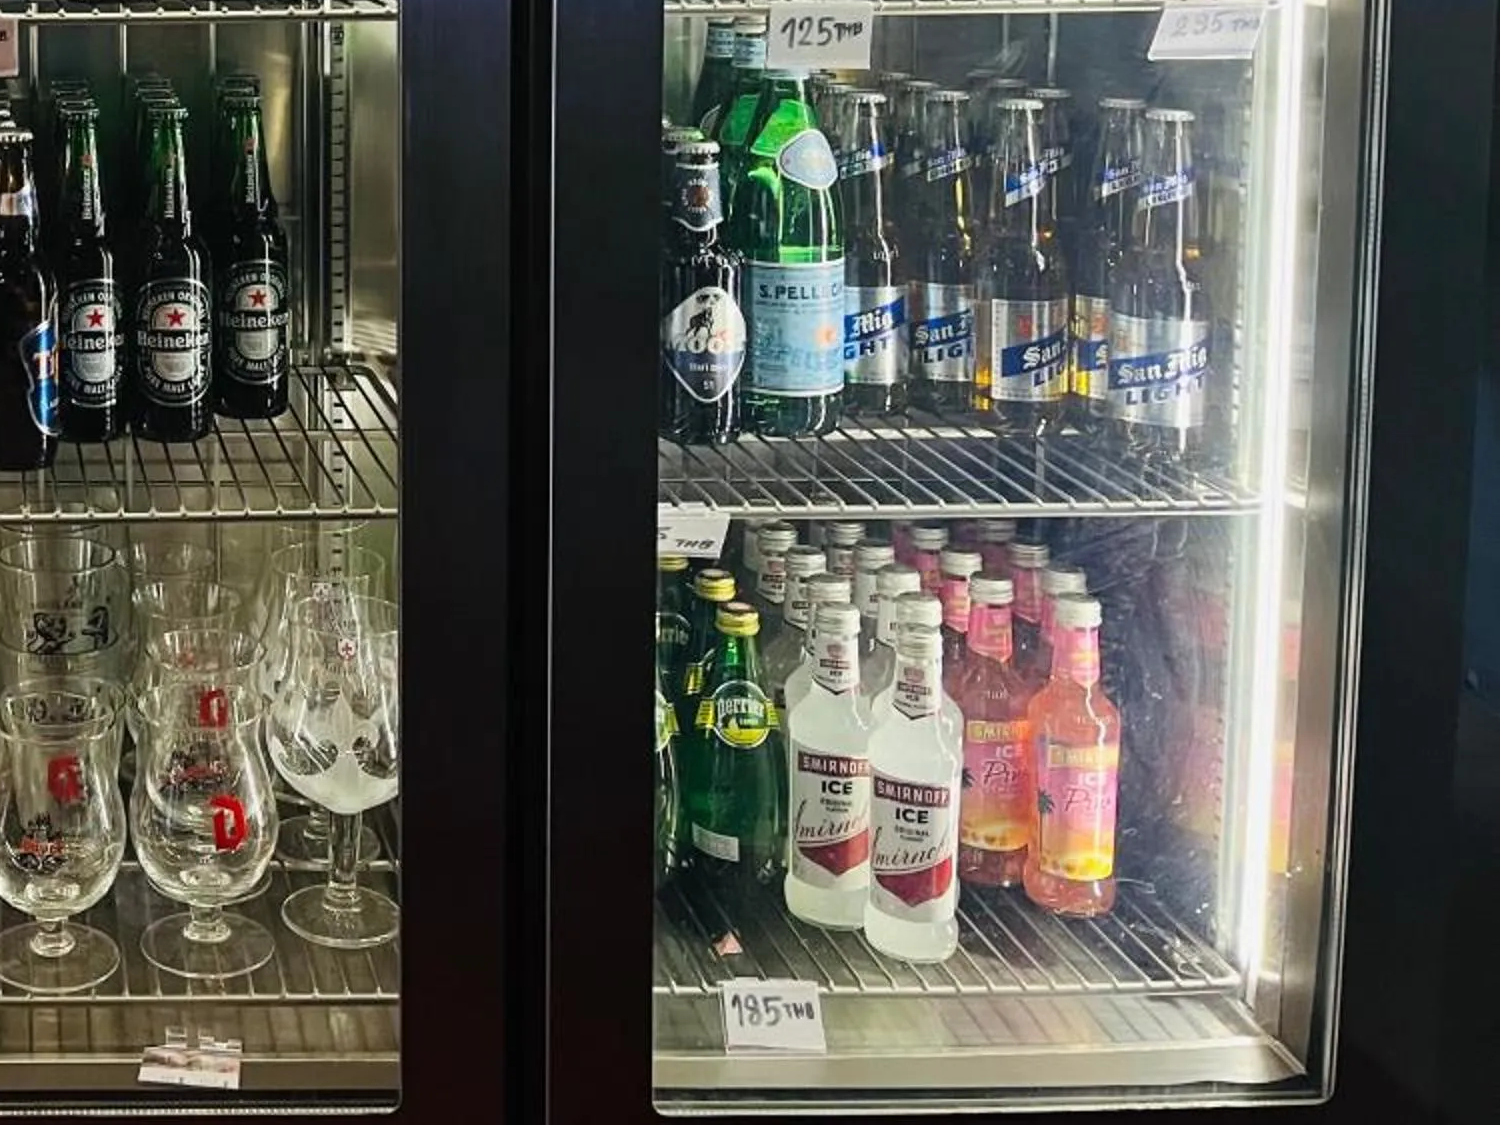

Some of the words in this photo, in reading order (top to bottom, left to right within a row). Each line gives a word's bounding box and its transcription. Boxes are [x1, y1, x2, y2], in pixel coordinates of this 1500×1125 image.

[851, 308, 895, 336] Mig
[821, 780, 853, 795] ICE
[877, 781, 949, 805] SMIRNOFF
[895, 808, 930, 825] ICE
